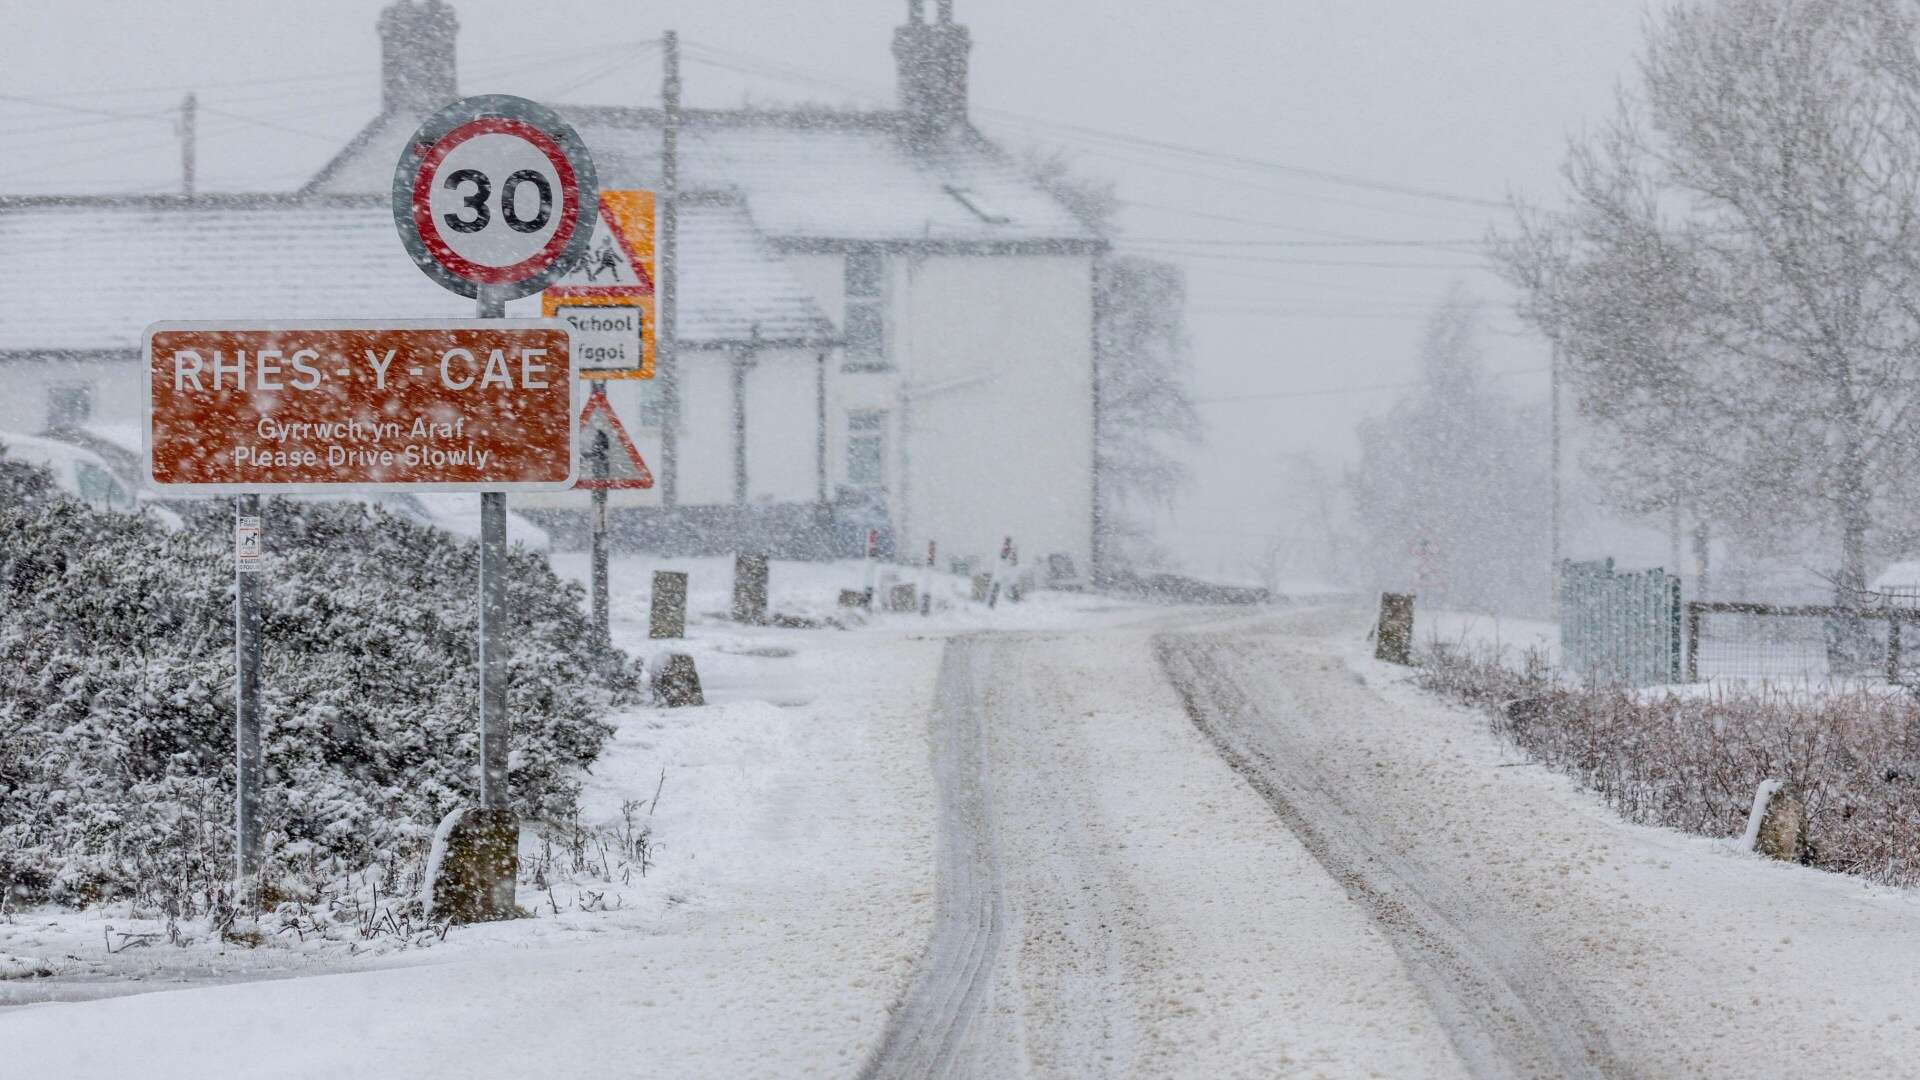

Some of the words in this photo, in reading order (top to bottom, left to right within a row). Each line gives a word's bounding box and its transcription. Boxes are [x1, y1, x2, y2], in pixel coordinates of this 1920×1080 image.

[443, 169, 553, 233] 30
[257, 417, 362, 442] Gyrrwch
[371, 423, 400, 443] yn
[411, 417, 465, 438] Araf
[234, 445, 317, 466] Please
[328, 446, 394, 467] Drive
[404, 446, 489, 468] Slowly
